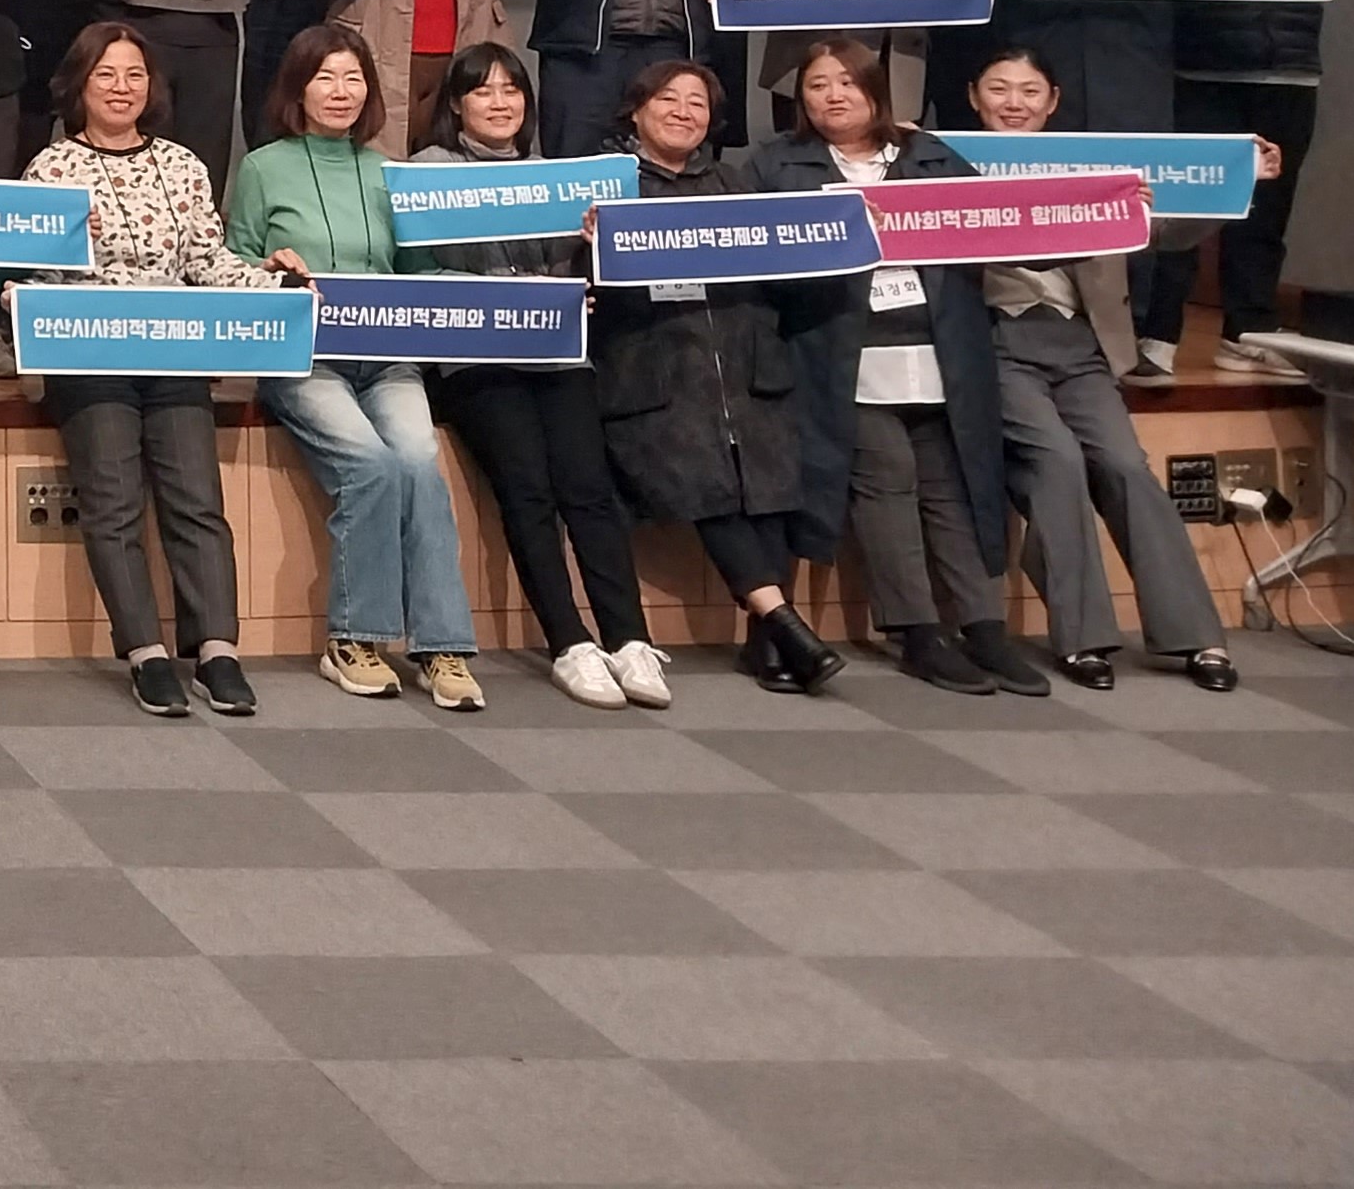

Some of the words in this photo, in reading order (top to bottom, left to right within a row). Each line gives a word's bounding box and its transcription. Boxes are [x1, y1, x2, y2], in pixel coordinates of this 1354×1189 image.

[391, 185, 552, 214] 안산시사회적경제와
[558, 179, 626, 206] 나누다!!
[1031, 200, 1131, 227] 함께하다!!
[614, 227, 770, 253] 안산시사회적경제와
[777, 221, 849, 246] 만나다!!
[34, 318, 207, 341] 안산시사회적경제와
[216, 321, 287, 342] 나누다!!
[320, 304, 485, 330] 안산시사회적경제와
[494, 310, 563, 331] 만나다!!
